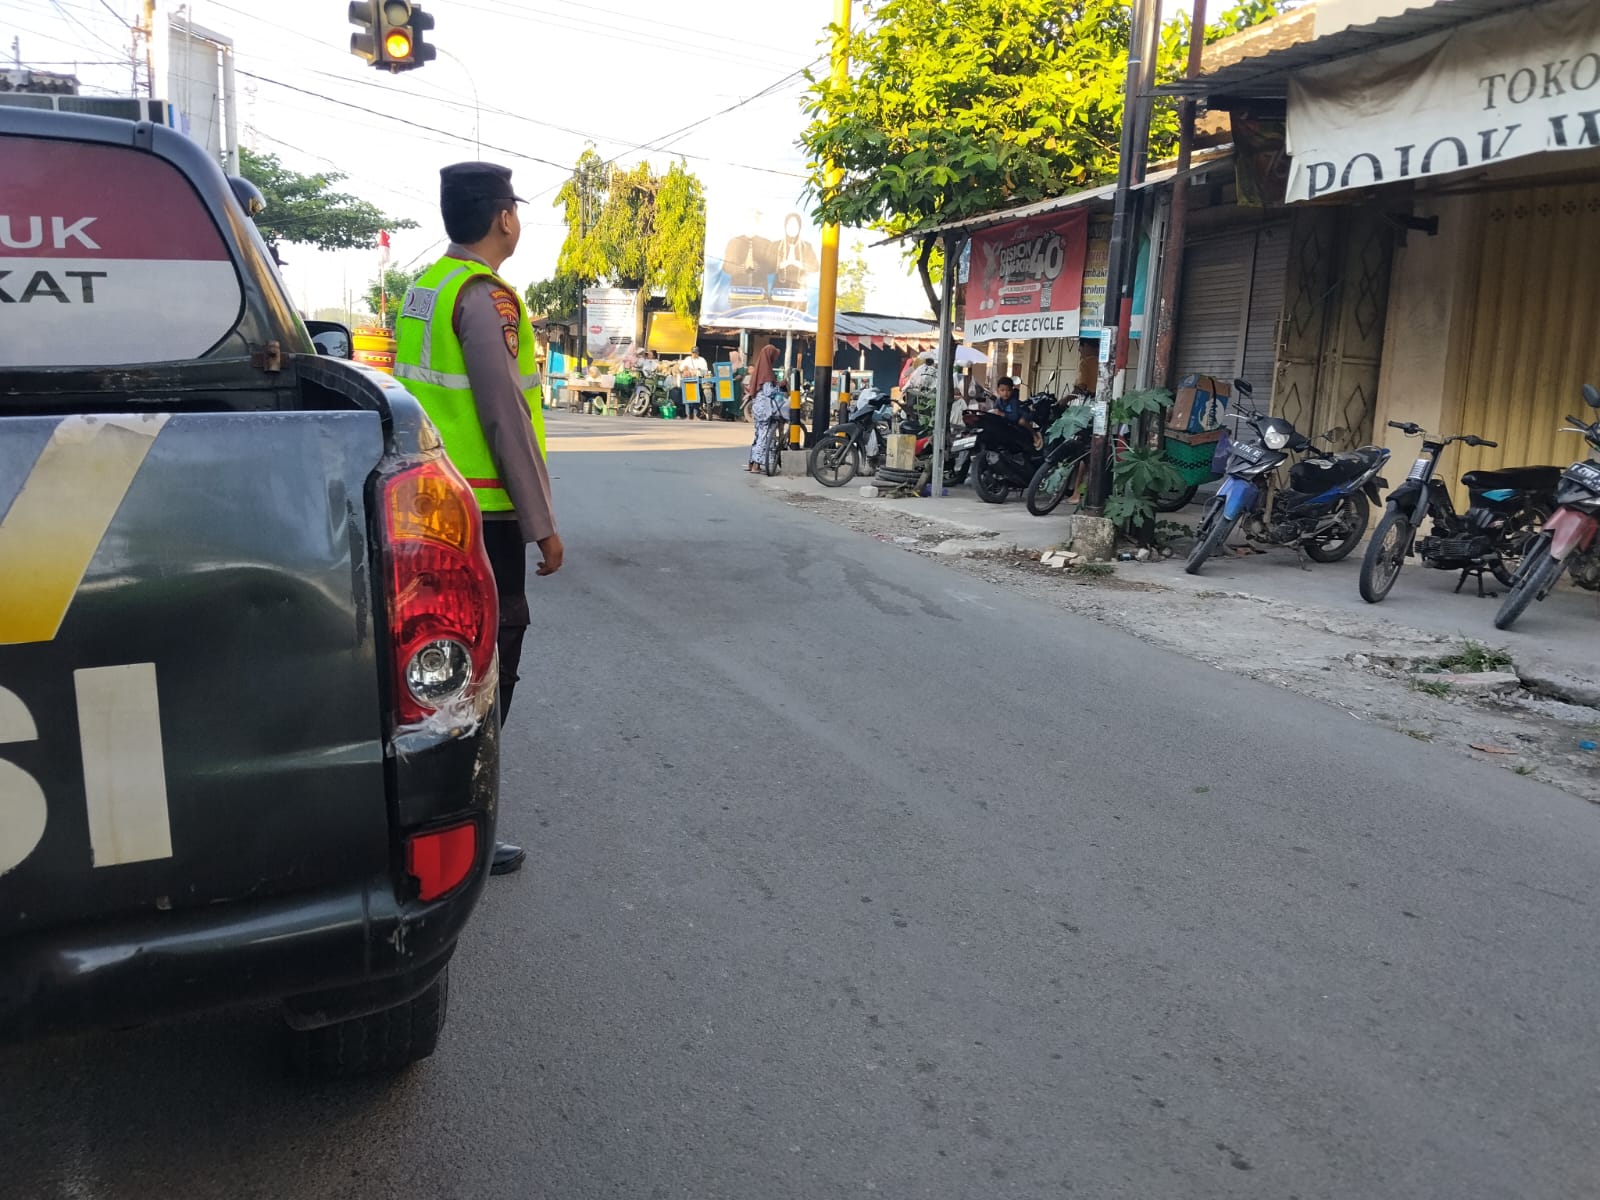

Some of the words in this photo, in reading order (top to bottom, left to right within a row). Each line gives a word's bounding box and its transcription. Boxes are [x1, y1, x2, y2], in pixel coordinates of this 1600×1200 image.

[1478, 52, 1600, 110] TOKO
[1001, 319, 1030, 333] CECE
[1031, 316, 1065, 332] CYCLE
